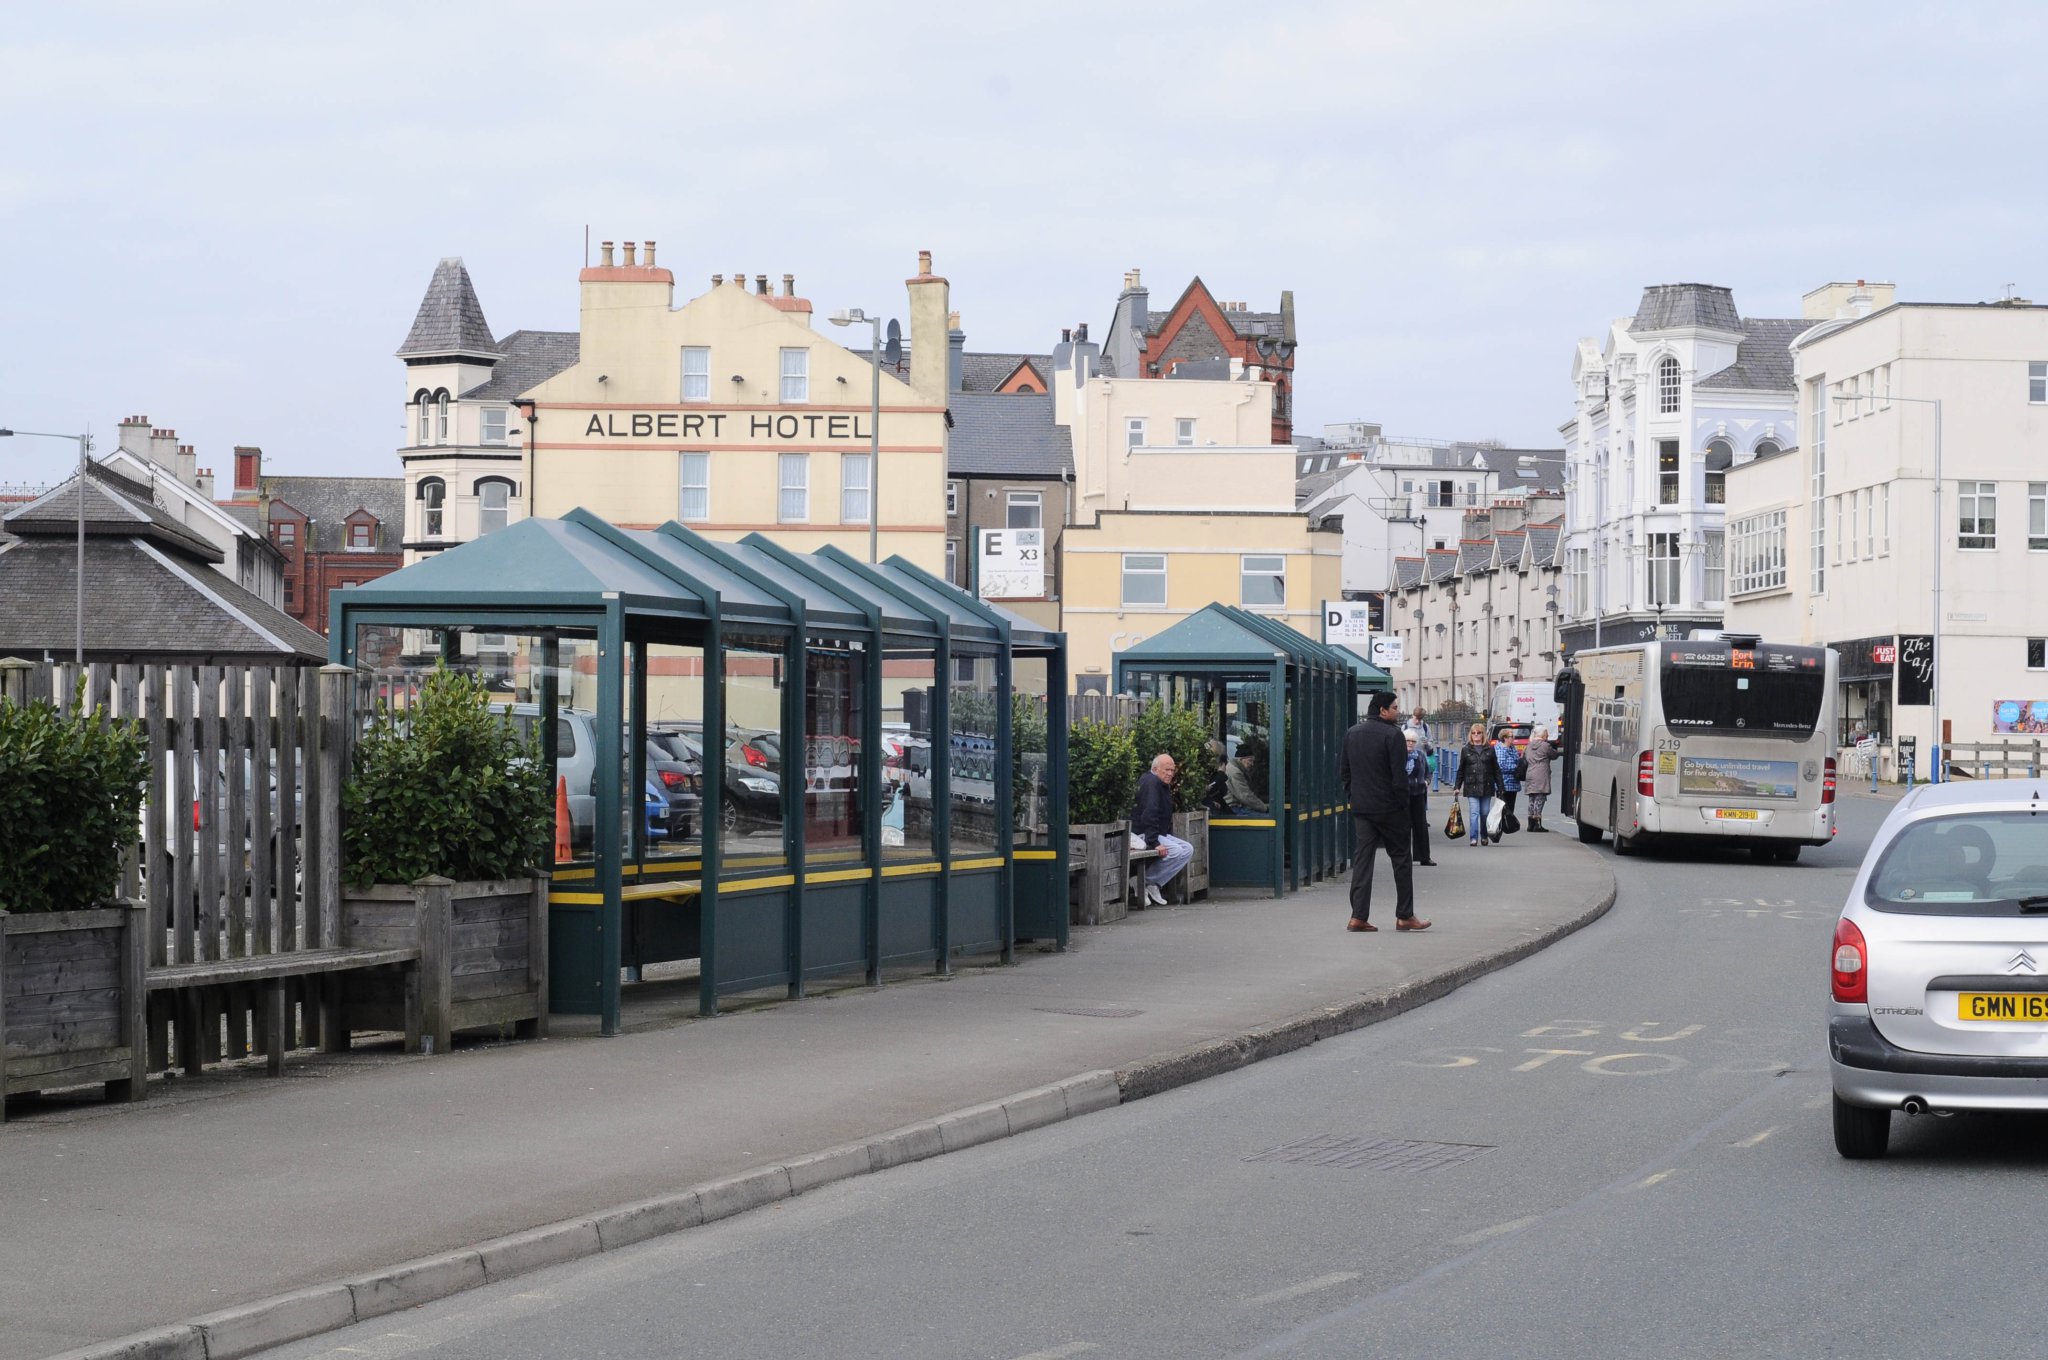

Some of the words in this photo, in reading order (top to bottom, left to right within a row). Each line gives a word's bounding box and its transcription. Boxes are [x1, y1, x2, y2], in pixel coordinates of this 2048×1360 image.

[585, 413, 727, 438] ALBERT
[750, 414, 873, 439] HOTEL
[986, 533, 1002, 555] E
[1020, 549, 1038, 560] X3
[1328, 611, 1343, 627] D
[1665, 624, 1679, 633] UKE
[1373, 643, 1384, 653] C
[1903, 636, 1931, 651] The
[1732, 649, 1753, 659] Port
[1875, 647, 1894, 655] JUST
[1696, 653, 1726, 661] 662525
[1880, 654, 1894, 662] EAT
[1732, 659, 1754, 669] Erin
[1658, 739, 1681, 750] 219
[1695, 761, 1704, 770] by
[1720, 762, 1750, 770] unlimited
[1752, 763, 1770, 771] travel
[1683, 768, 1693, 776] for
[1708, 769, 1724, 778] days
[1972, 997, 2016, 1017] GMN
[2022, 997, 2048, 1017] 16
